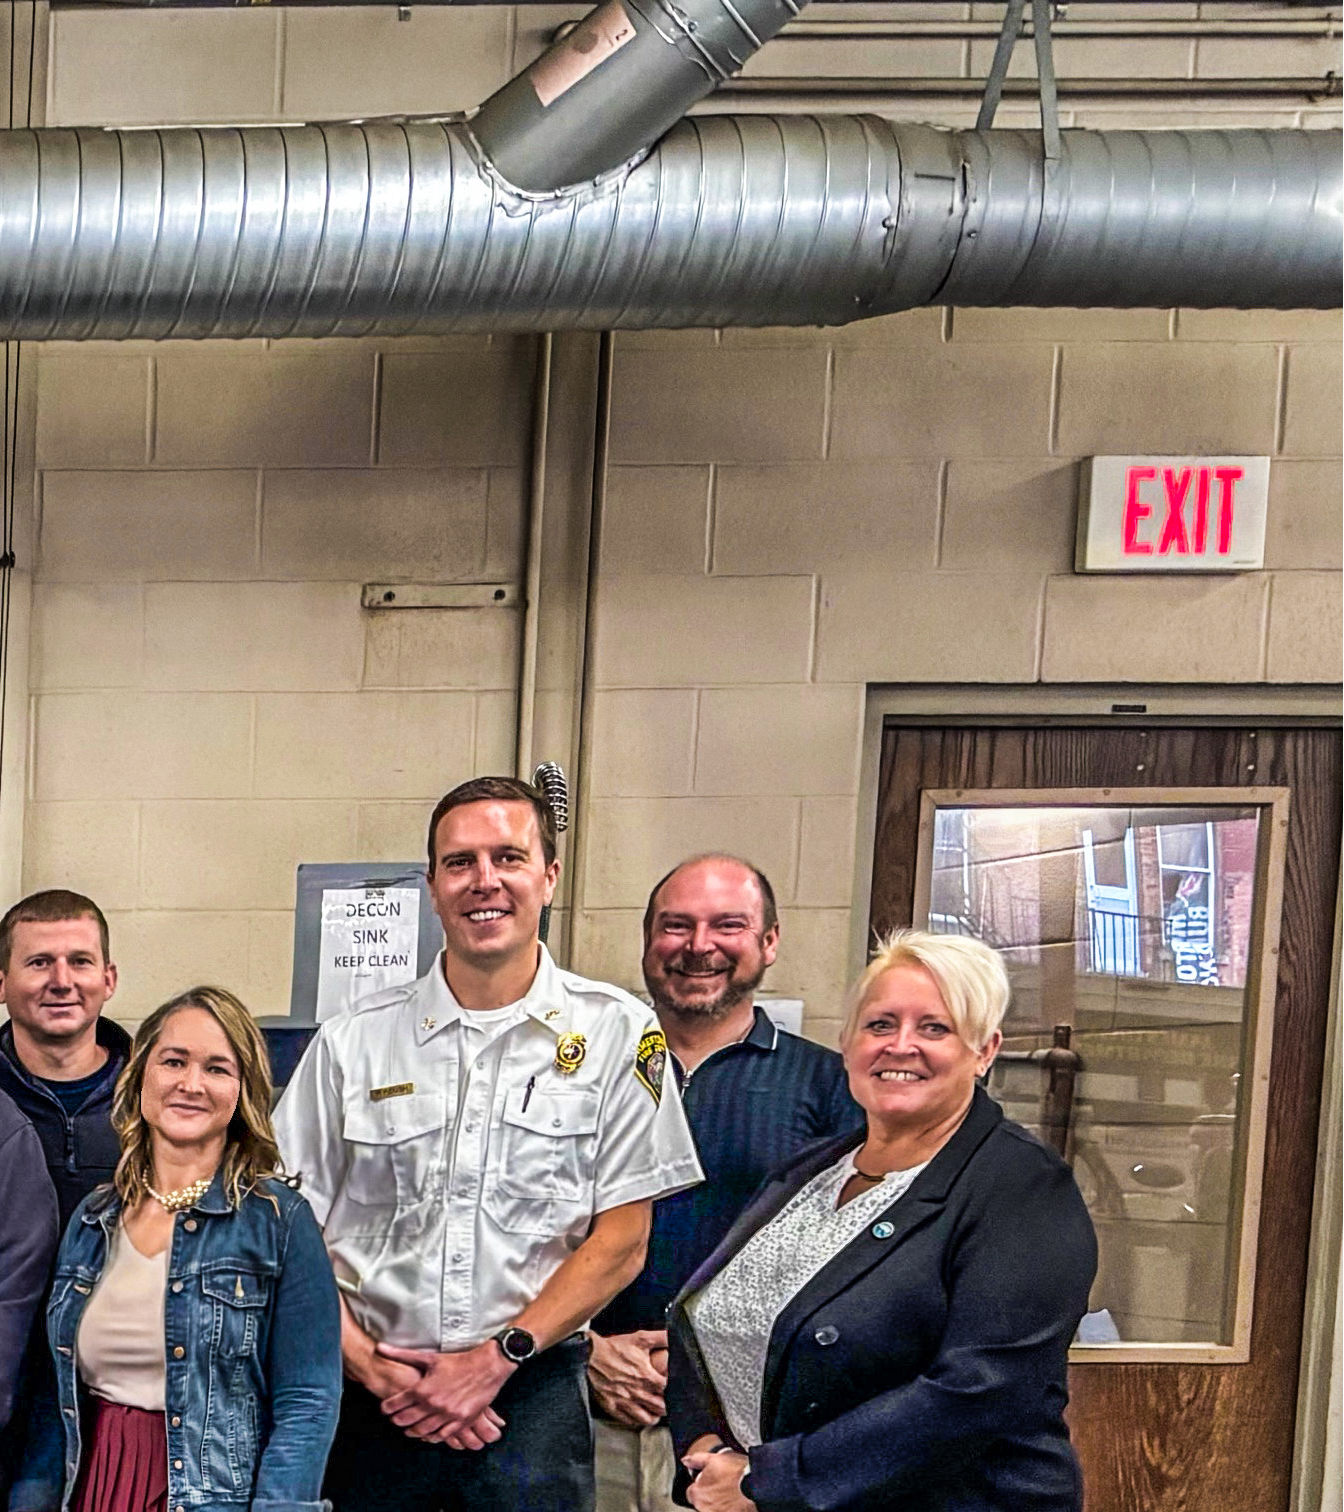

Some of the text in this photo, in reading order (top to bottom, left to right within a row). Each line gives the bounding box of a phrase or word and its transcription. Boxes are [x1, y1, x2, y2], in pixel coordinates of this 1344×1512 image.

[1122, 466, 1245, 556] EXIT
[346, 902, 401, 917] DECON
[353, 929, 389, 944] SINK
[334, 954, 408, 968] KEEP CLEAN
